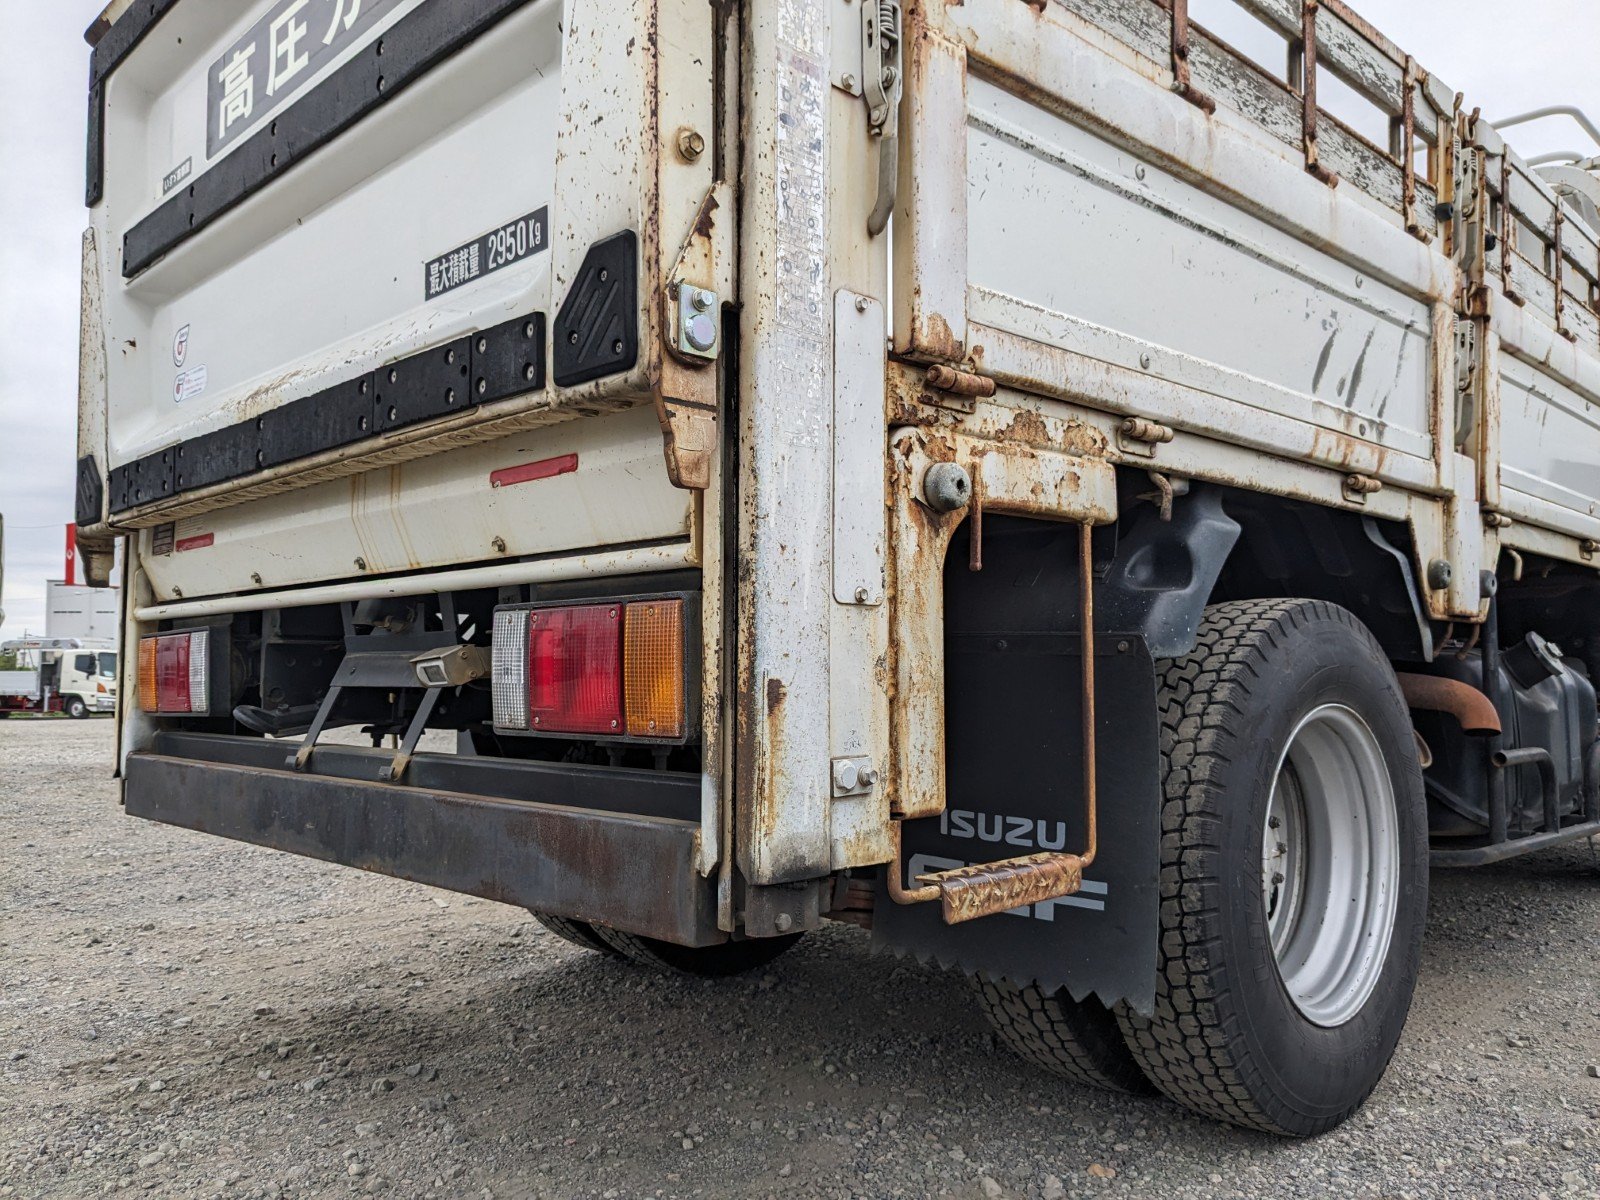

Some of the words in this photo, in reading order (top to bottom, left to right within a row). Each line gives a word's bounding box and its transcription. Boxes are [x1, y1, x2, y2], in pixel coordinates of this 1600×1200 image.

[429, 243, 480, 294] 最大積載量
[488, 220, 526, 270] 2950
[940, 808, 1066, 850] ISUZU
